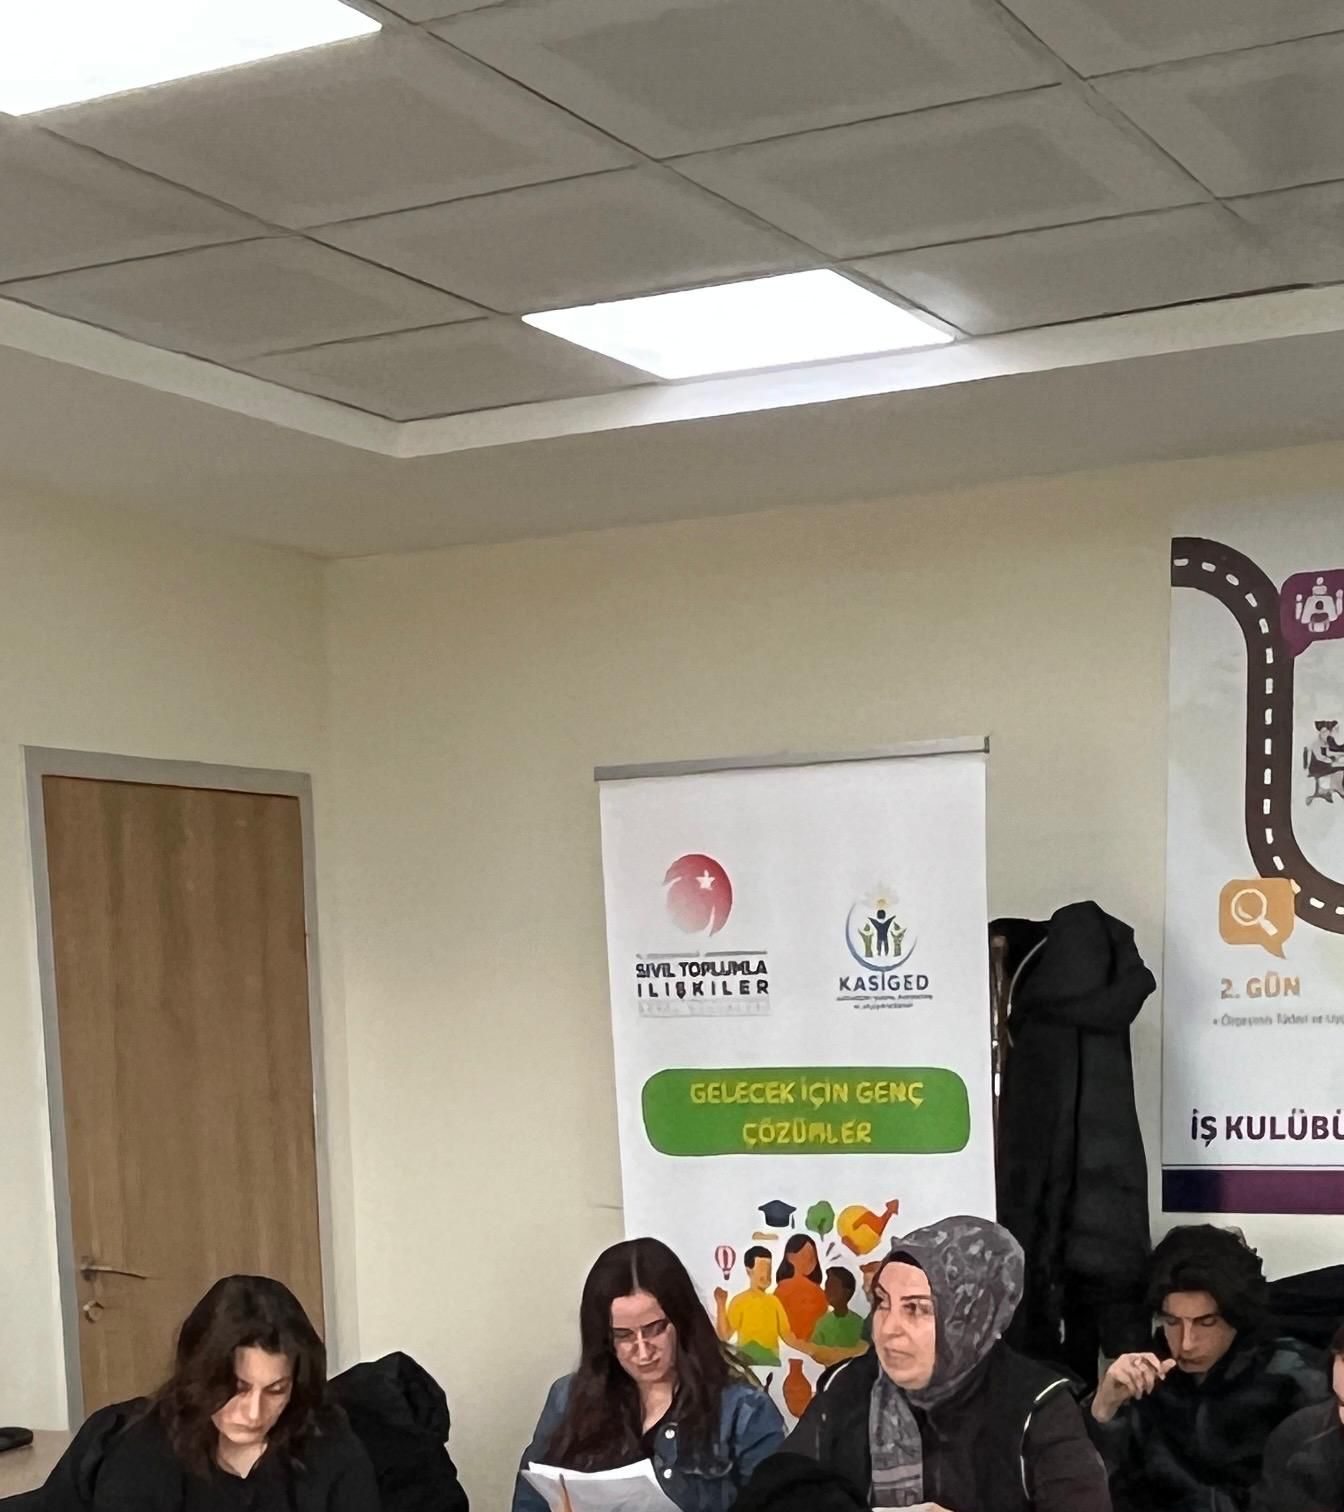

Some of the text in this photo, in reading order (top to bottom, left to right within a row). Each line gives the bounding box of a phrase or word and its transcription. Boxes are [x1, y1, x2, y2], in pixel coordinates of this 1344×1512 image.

[680, 959, 768, 978] TOPLUMLA
[1221, 970, 1301, 999] 2. GÜN
[689, 1076, 925, 1110] GELECEK İÇİN GENÇ
[742, 1116, 873, 1148] ÇÖZÜMLER
[1191, 1107, 1217, 1148] İŞ
